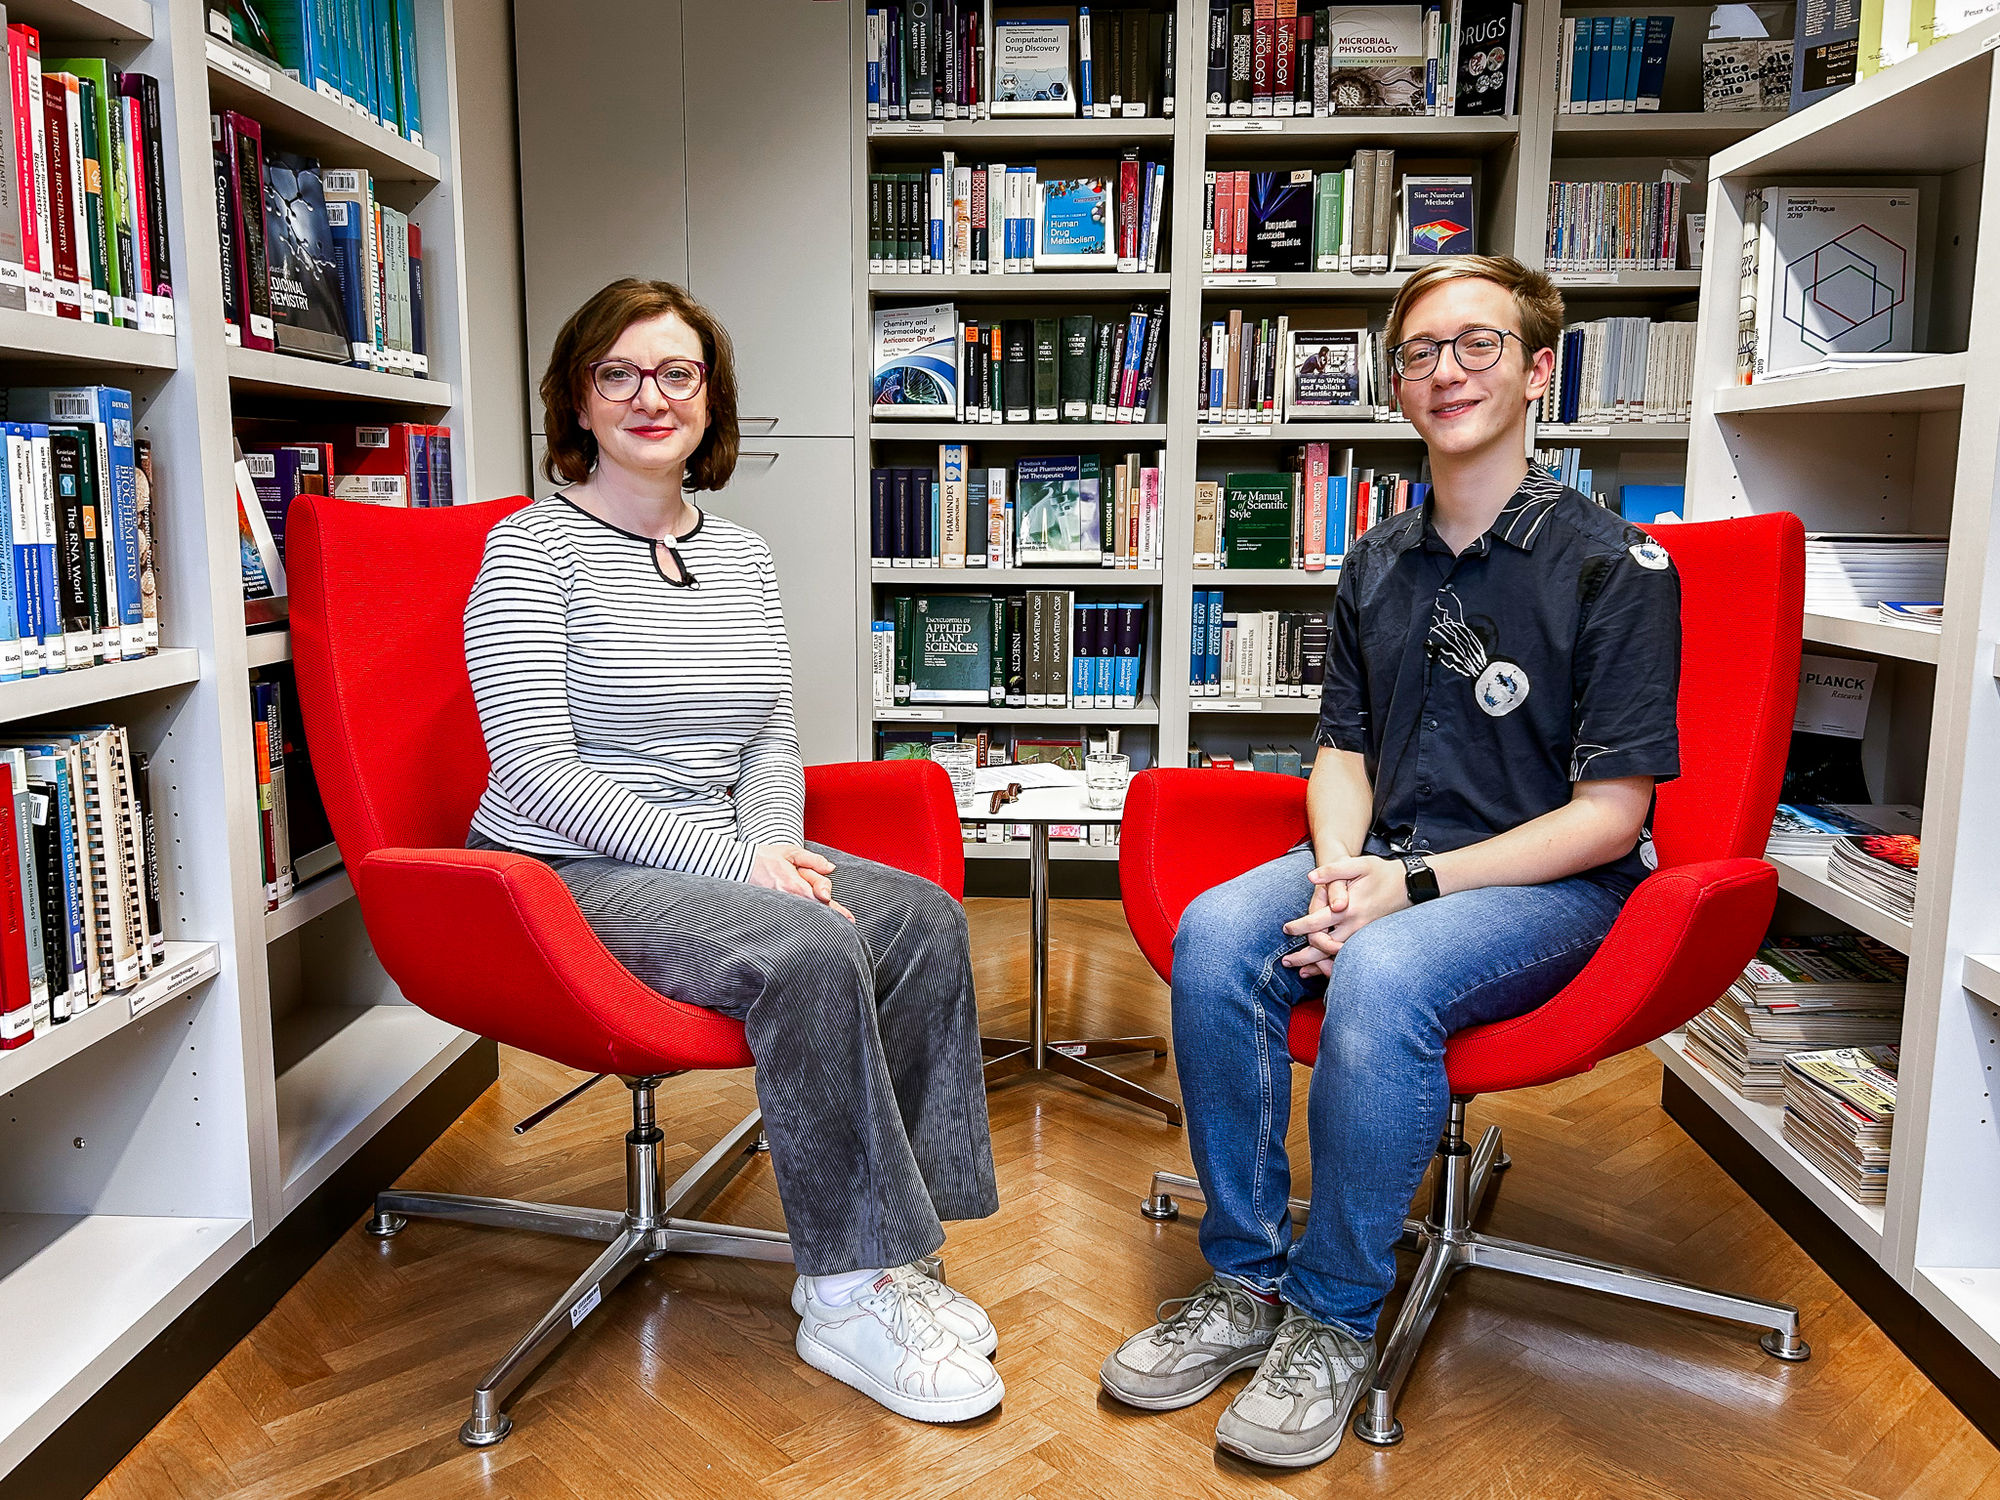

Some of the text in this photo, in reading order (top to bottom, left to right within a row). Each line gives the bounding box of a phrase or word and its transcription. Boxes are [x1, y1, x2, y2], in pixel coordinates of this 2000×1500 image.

[911, 21, 919, 51] Agents
[1005, 35, 1059, 45] Computational
[1338, 37, 1391, 45] MICROBIAL
[919, 20, 929, 76] Antimicrobial
[1005, 43, 1061, 54] Drug Discovery
[1254, 25, 1267, 87] VIROLOGY
[1276, 24, 1289, 86] VIROLOGY
[1339, 45, 1399, 54] PHYSIOLOGY
[945, 29, 954, 95] ANTIVIRAL DRUGS
[20, 116, 28, 159] chemistry
[152, 141, 162, 188] Biochemistry
[33, 152, 43, 218] Biochemistry
[51, 118, 68, 254] MEDICAL BIOCHEMISTRY
[155, 188, 163, 200] and
[1429, 191, 1465, 199] Numerical
[1424, 198, 1454, 206] Methods
[1787, 197, 1818, 206] Research
[1812, 205, 1836, 213] Prague
[1050, 219, 1079, 229] Human
[1050, 229, 1070, 238] Drug
[140, 230, 149, 262] CANCER
[158, 234, 167, 262] Biology
[216, 175, 233, 307] Concise Dictionary
[1050, 235, 1096, 246] Metabolism
[367, 189, 383, 329] IMMUNOBIOLOGY
[1, 267, 18, 279] BioCh
[59, 287, 75, 297] BioCh
[883, 317, 928, 328] Chemistry and
[883, 324, 937, 338] Pharmacology of
[882, 335, 936, 345] Anticancer Drugs
[1756, 358, 1765, 375] 2019
[1300, 383, 1314, 391] and
[1300, 389, 1353, 399] Scientific Paper
[945, 448, 962, 481] 98
[1019, 465, 1078, 474] Clinical Pharmacology
[115, 479, 123, 503] Clinical
[1199, 488, 1214, 499] ies
[1230, 490, 1284, 501] The Manual
[945, 485, 954, 541] PHARMINDEX
[1229, 509, 1253, 521] Style
[1237, 500, 1289, 511] of Scientific
[119, 465, 138, 582] BIOCHEMISTRY
[143, 496, 153, 546] Therapeutic
[1105, 502, 1114, 548] TOXIKOLOGIE
[23, 547, 31, 568] Protein
[66, 505, 86, 604] The RNA World
[24, 569, 32, 591] Kinases
[31, 547, 43, 625] Protein Structure Prediction
[51, 546, 62, 626] Proteomics Drug Research
[28, 615, 36, 636] Targets
[925, 616, 963, 624] ENCYCLOPEDIA
[925, 623, 972, 634] APPLIED
[1194, 602, 1206, 656] CIZÍCH SLOV
[1212, 602, 1222, 656] CIZÍCH SLOV
[924, 642, 979, 653] SCIENCES
[925, 632, 965, 643] PLANT
[1012, 632, 1021, 672] INSECTS
[1032, 642, 1041, 663] NOVÁ
[1052, 642, 1061, 663] NOVÁ
[1805, 672, 1867, 691] PLANCK
[1830, 690, 1864, 701] Research
[20, 801, 38, 922] ENVIRONMENTAL BIOTECHNOLOGY
[60, 779, 79, 926] Introduction to BIOINFORMATICS
[14, 1017, 31, 1029] BioGen
